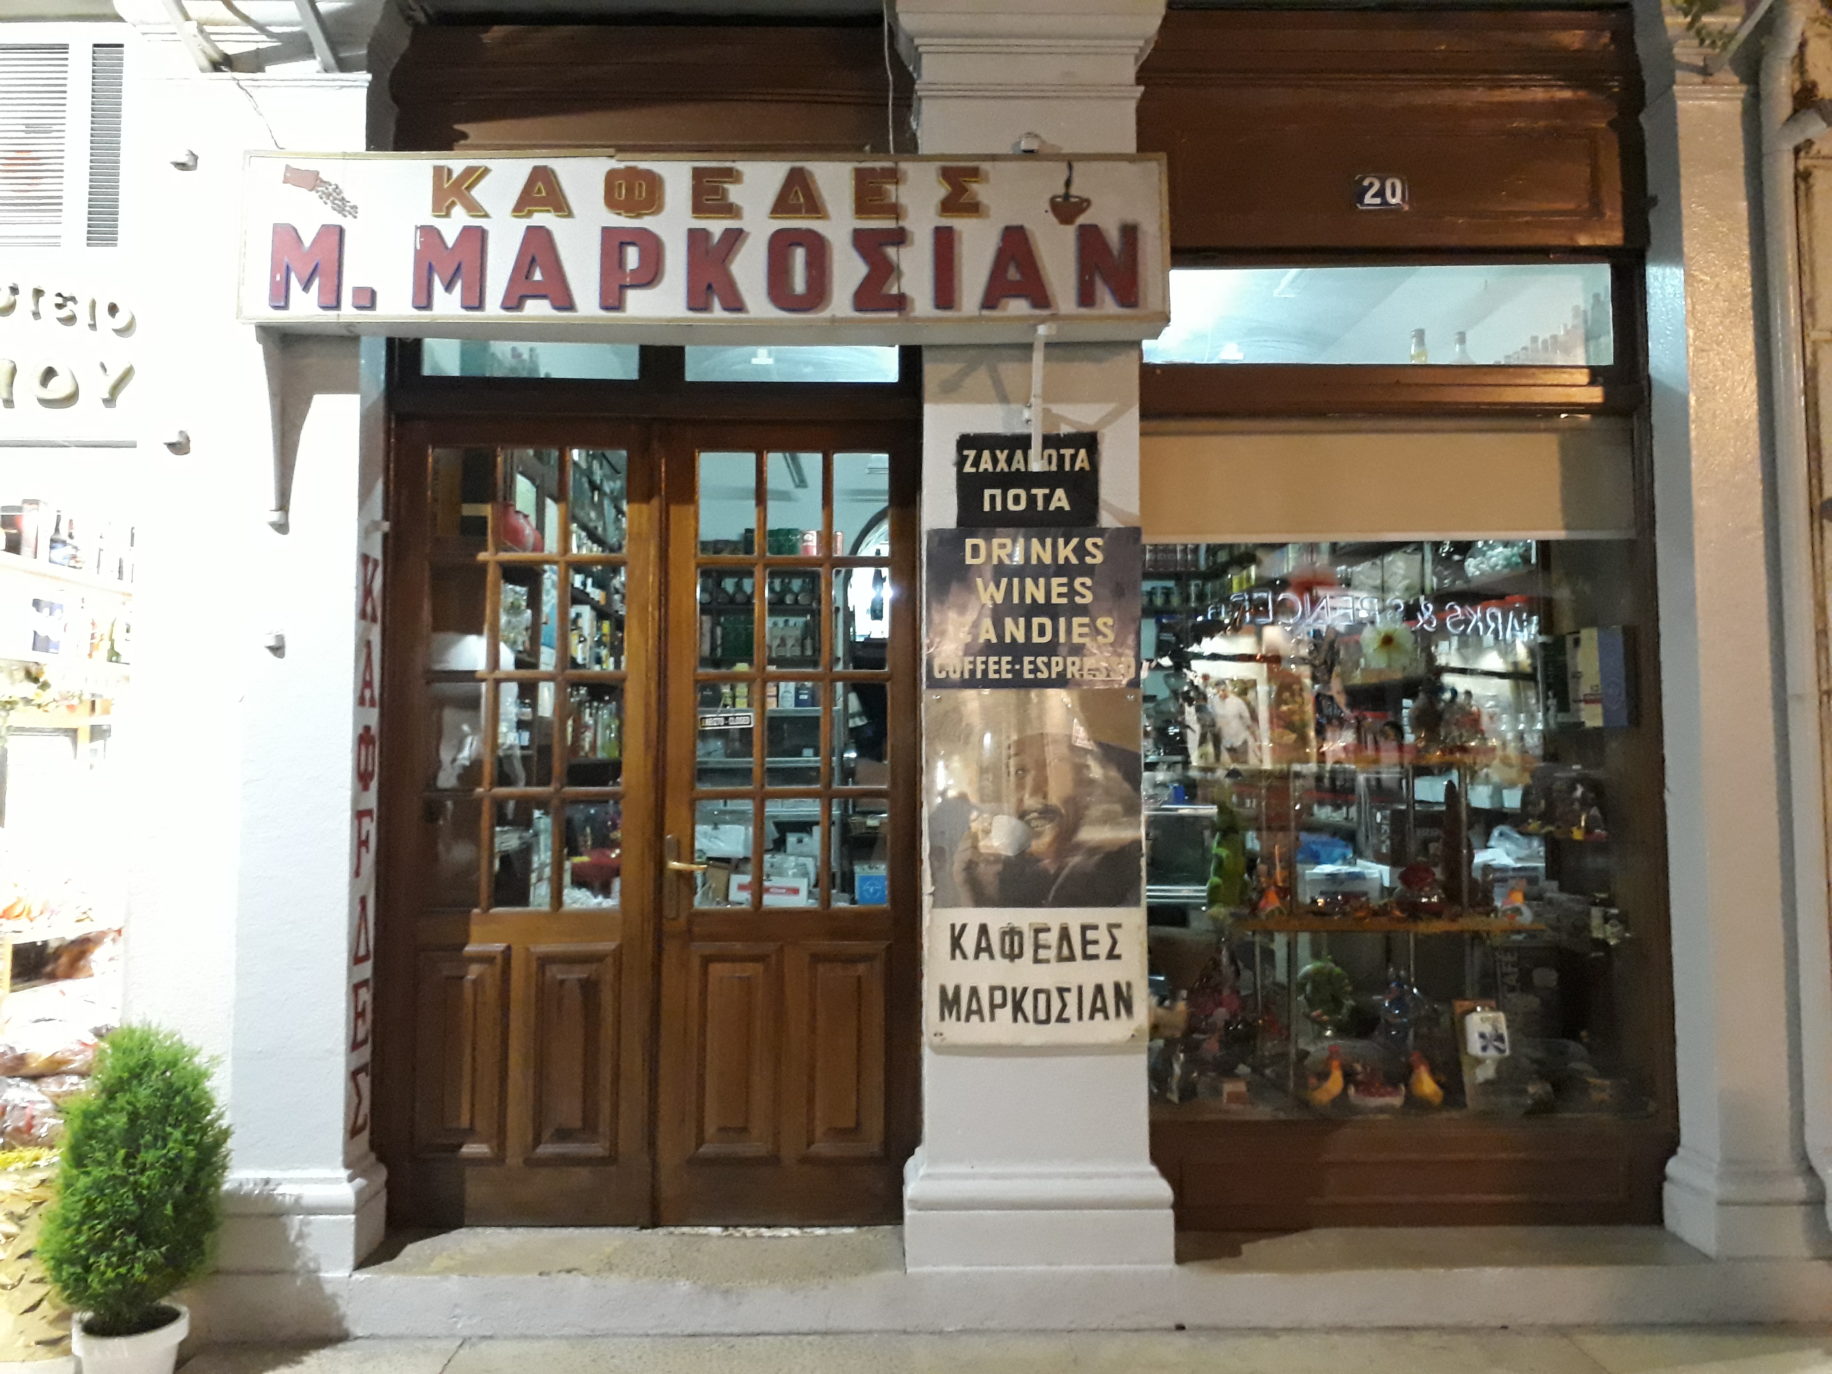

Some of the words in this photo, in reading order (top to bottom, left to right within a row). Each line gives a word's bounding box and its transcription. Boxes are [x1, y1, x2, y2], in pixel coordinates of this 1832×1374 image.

[431, 164, 983, 220] ΚΑΦΕΔΕΣ
[1362, 176, 1402, 204] 20
[269, 222, 376, 310] Μ.
[411, 222, 1139, 313] ΜΑΡΚΟΣΙΑΝ
[982, 488, 1071, 512] ΠΟΤΑ
[964, 537, 1105, 565] DRINKS
[976, 577, 1093, 604] WINES
[957, 616, 1115, 644] ANDIES
[949, 922, 1123, 964] ΚΑΦΕΔΕΣ
[938, 980, 1134, 1025] ΜΑΡΚΟΣΙΑΝ
